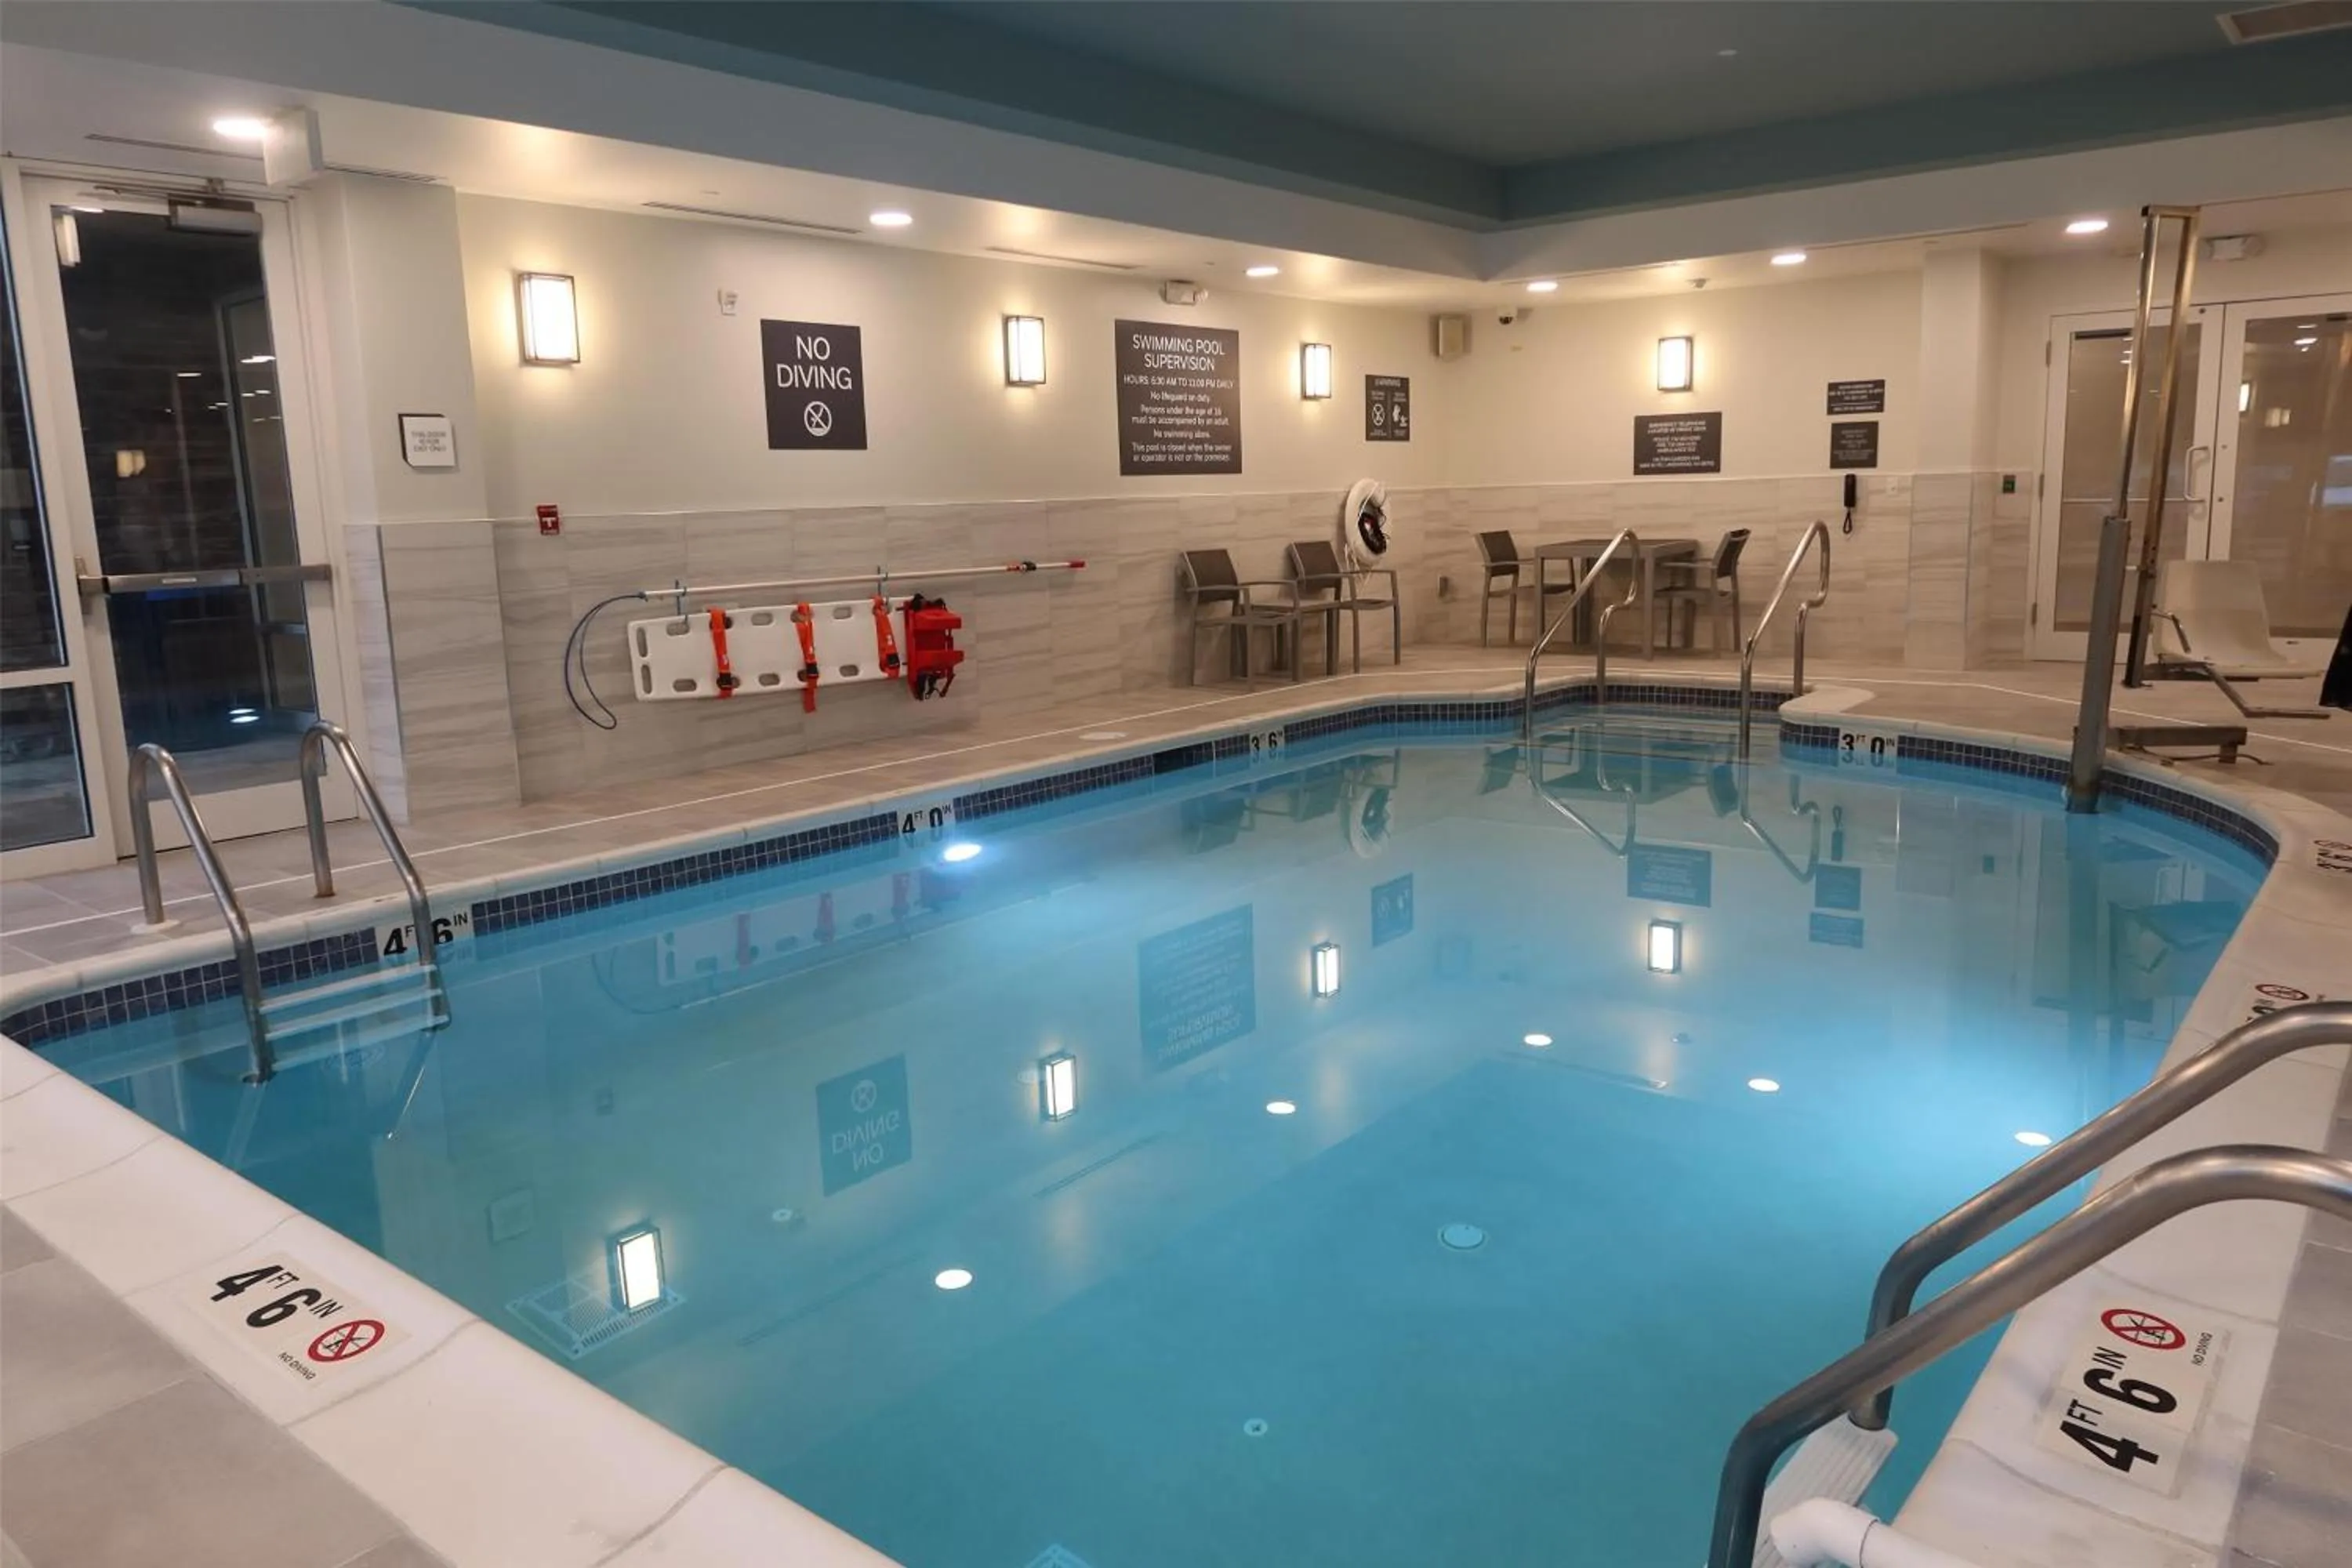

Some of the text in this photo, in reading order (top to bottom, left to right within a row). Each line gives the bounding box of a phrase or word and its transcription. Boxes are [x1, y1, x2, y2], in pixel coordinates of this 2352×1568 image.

[796, 335, 830, 361] NO
[1132, 334, 1226, 355] SWIMMING POOL
[1144, 354, 1215, 371] SUPERVISION
[776, 363, 852, 390] DIVING
[1166, 376, 1177, 386] AM
[1178, 377, 1188, 387] TO
[1206, 379, 1215, 388] PM
[1251, 736, 1260, 751] 3
[1269, 731, 1277, 750] 6
[1841, 734, 1854, 750] 3
[1871, 737, 1885, 753] 0
[902, 813, 916, 833] 4
[929, 808, 943, 828] 0
[383, 927, 408, 956] 4
[431, 918, 454, 945] 6
[453, 913, 468, 926] IN
[210, 1265, 344, 1328] 4 FT 6 IN
[278, 1351, 292, 1363] NO
[2191, 1352, 2205, 1366] NO
[2060, 1346, 2177, 1473] 4 FT 6 IN
